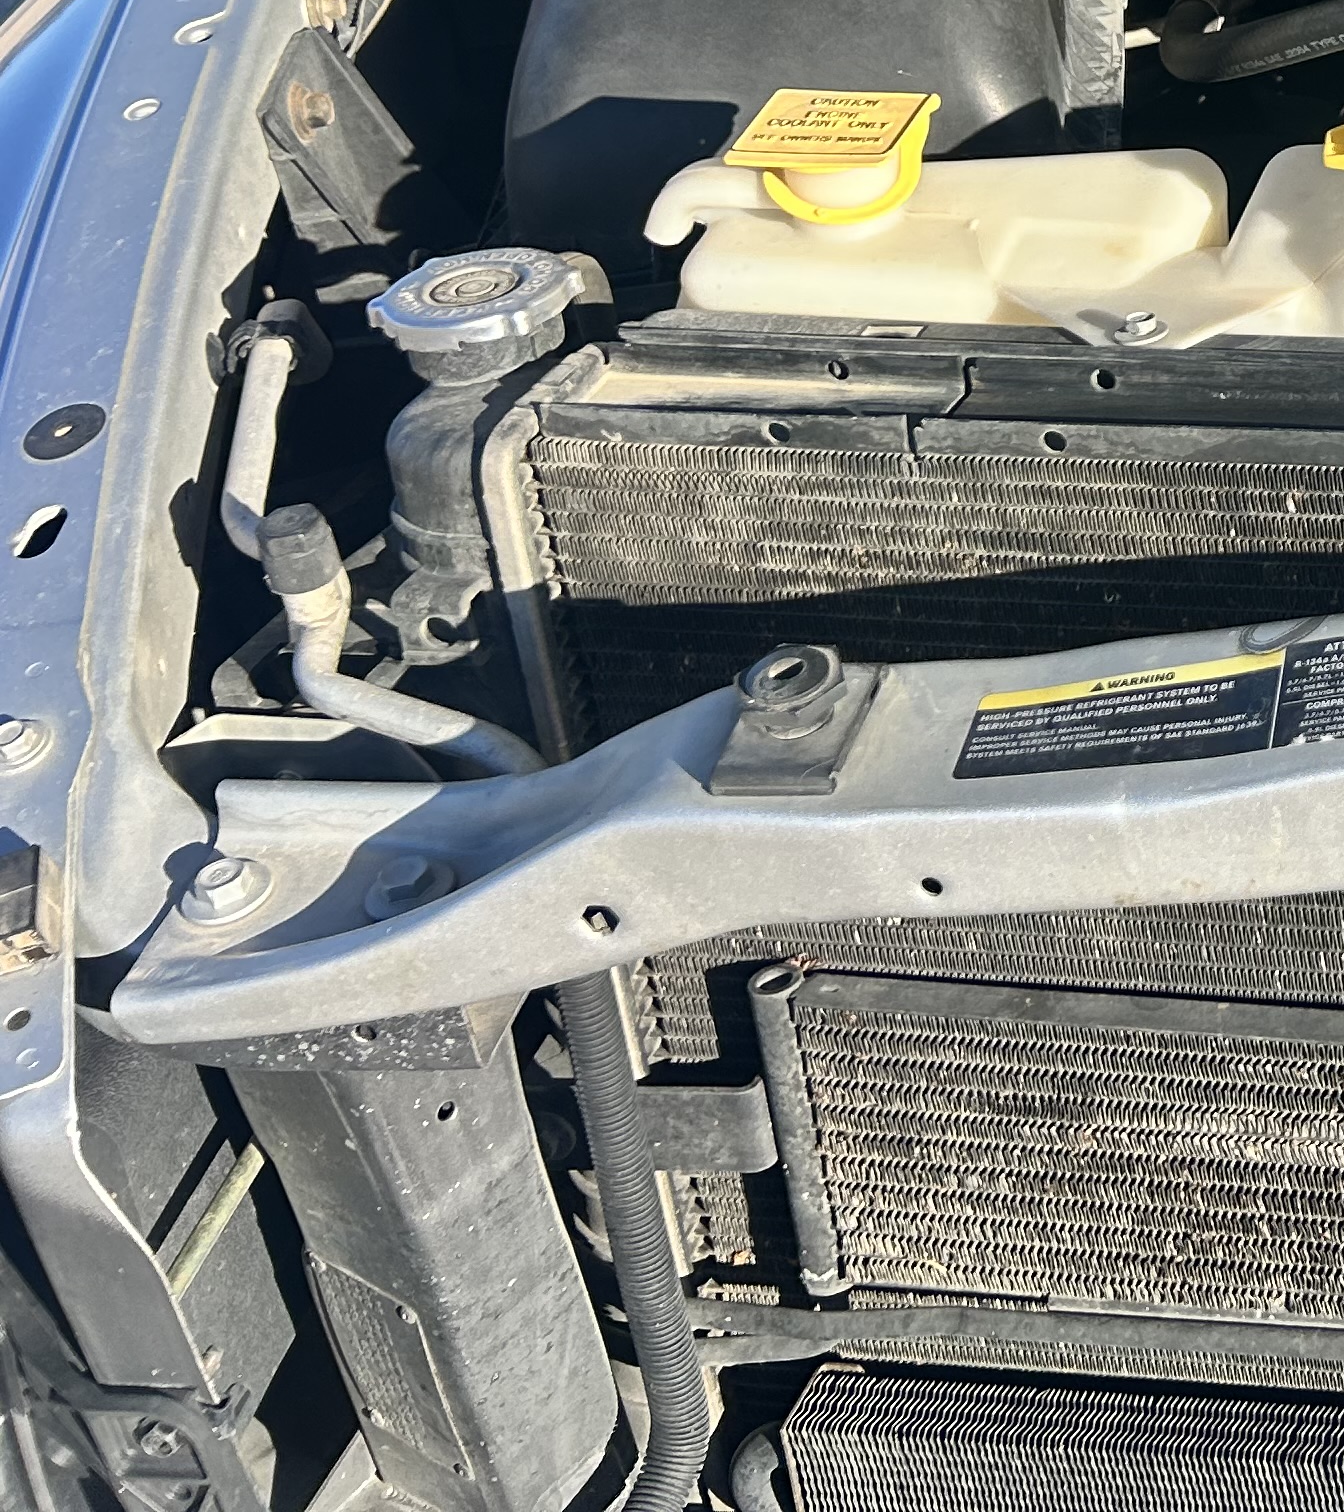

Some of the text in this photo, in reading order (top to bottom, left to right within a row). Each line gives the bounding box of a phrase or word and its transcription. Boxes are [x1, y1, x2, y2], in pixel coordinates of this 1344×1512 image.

[810, 97, 881, 108] CAUTION
[766, 117, 890, 130] COOLANT ONLY
[1106, 670, 1177, 690] WARNING
[1073, 691, 1154, 711] REFRIGERANT
[1153, 684, 1202, 700] SYSTEM
[1203, 682, 1219, 693] TO
[1219, 679, 1236, 691] BE
[974, 692, 1219, 732] SERVICED BY QUALIFIED PERSONNEL ONLY.
[970, 732, 1016, 744] CONSULT
[1016, 727, 1057, 739] SERVICE
[1018, 735, 1059, 747] SERVICE
[1107, 727, 1129, 736] MAY
[1129, 723, 1162, 734] CAUSE
[1161, 717, 1212, 730] PERSONAL
[1183, 723, 1235, 737] STANDARD
